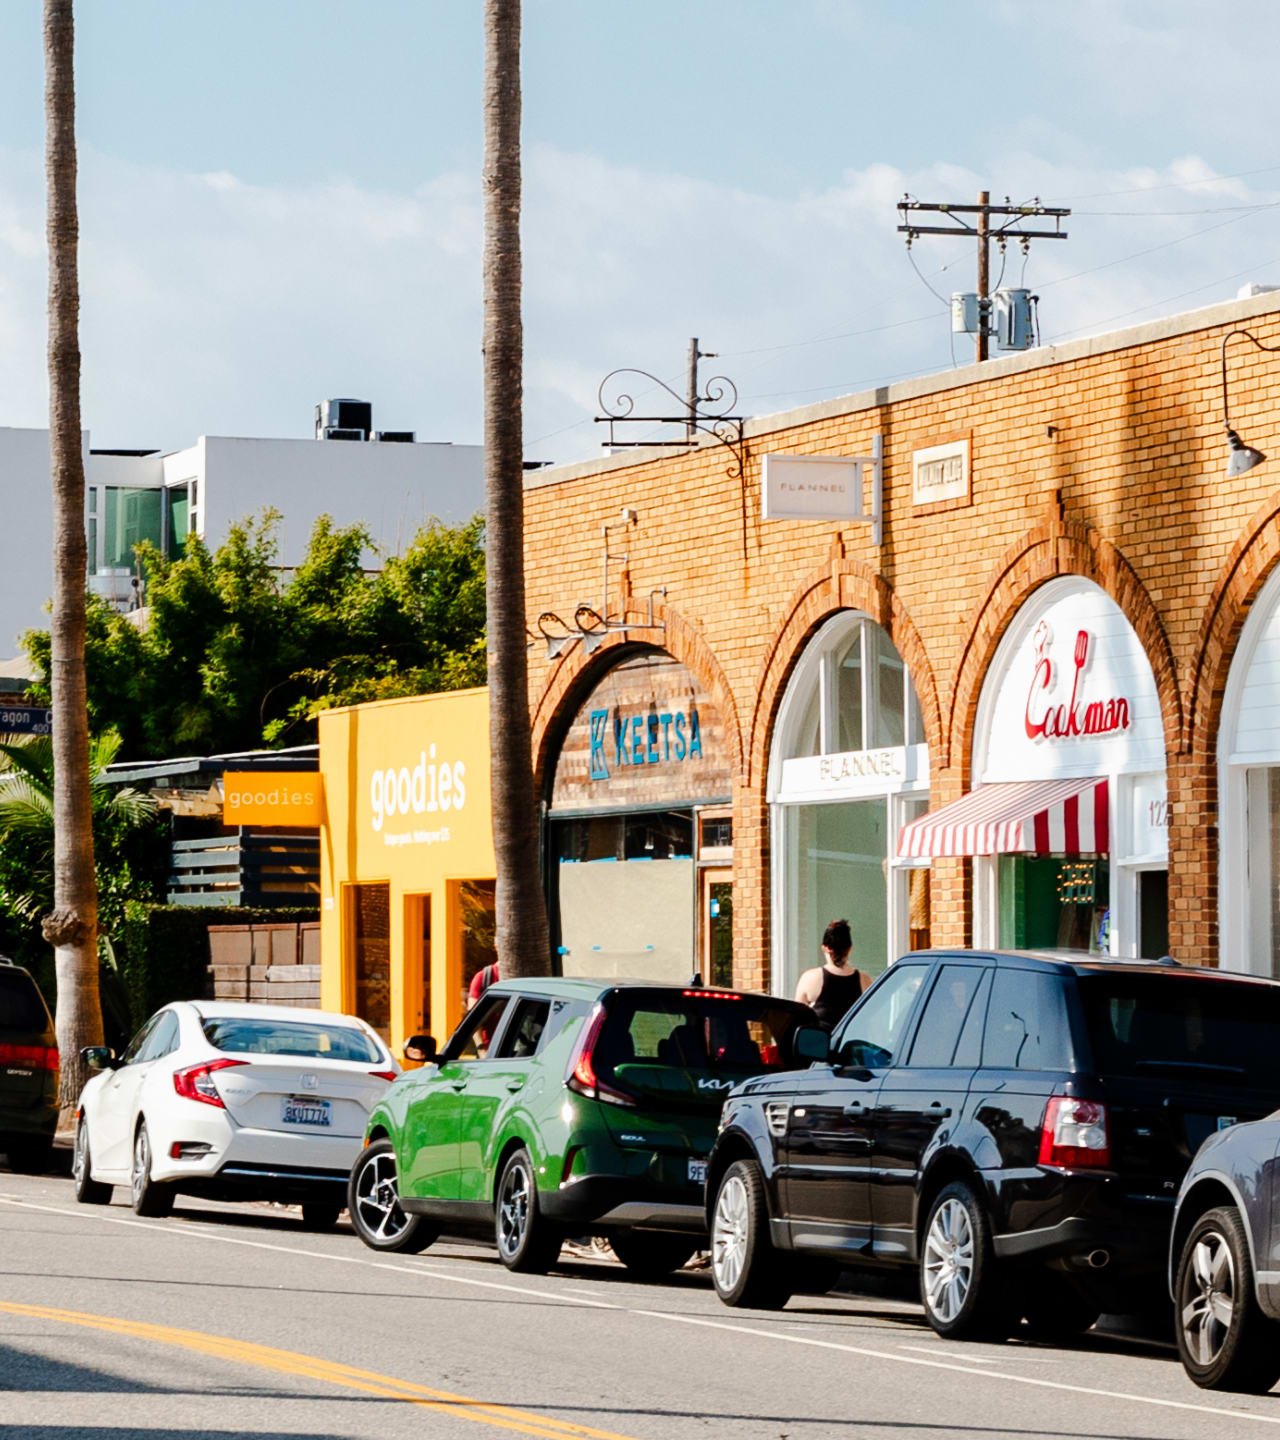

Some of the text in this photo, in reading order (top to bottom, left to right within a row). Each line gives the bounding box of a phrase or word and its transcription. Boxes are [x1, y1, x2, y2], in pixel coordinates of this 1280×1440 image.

[780, 482, 846, 493] FLANNEL
[1025, 630, 1129, 740] Cookman
[32, 723, 49, 734] 400
[614, 709, 703, 766] KEETSA
[229, 788, 314, 808] goodies
[371, 743, 466, 832] goodies
